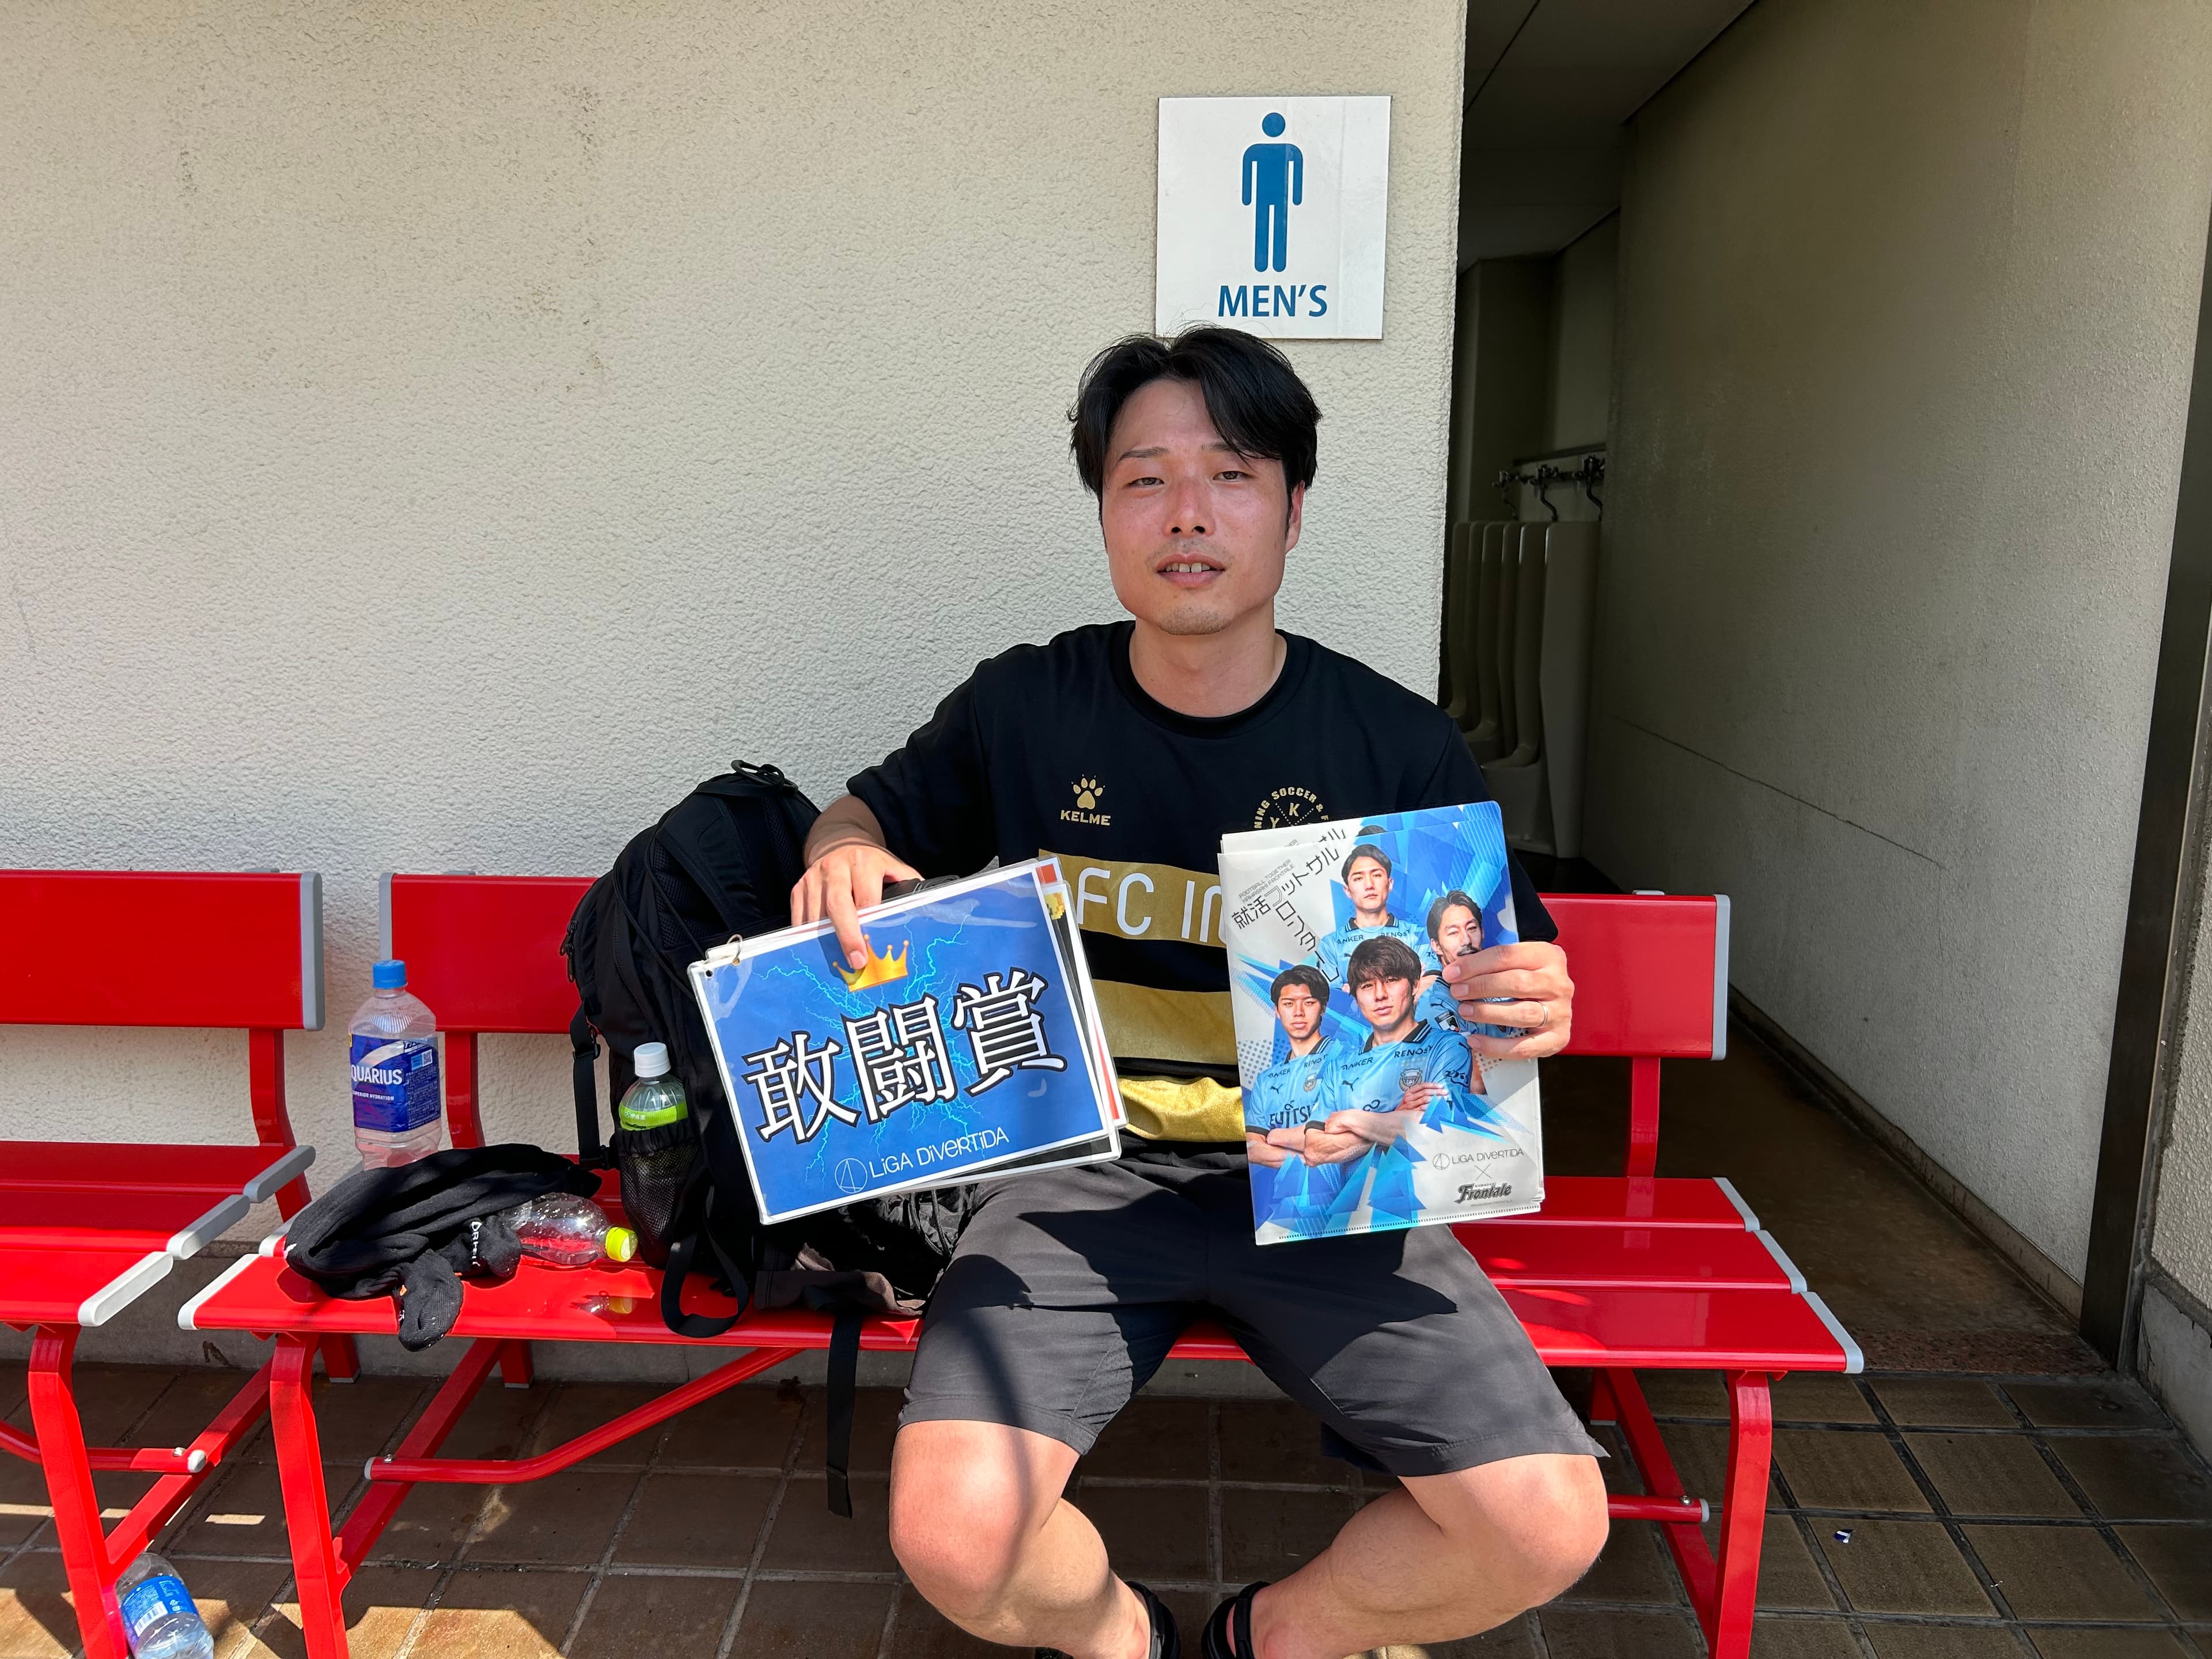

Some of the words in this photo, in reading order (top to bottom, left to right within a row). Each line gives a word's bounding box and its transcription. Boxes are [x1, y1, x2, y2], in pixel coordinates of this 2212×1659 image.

[1218, 285, 1328, 317] MEN'S
[1271, 787, 1317, 803] SOCCER
[1060, 809, 1111, 825] KELME
[1239, 878, 1267, 899] FOOTBALL
[1264, 859, 1291, 880] TOGETHER
[1077, 867, 1154, 935] FC
[1336, 934, 1364, 945] ANKER
[742, 966, 1067, 1144] 敢闘賞
[1394, 1045, 1433, 1058] RENOSY
[351, 1064, 402, 1085] QUARIUS
[1454, 1183, 1512, 1204] Frontale
